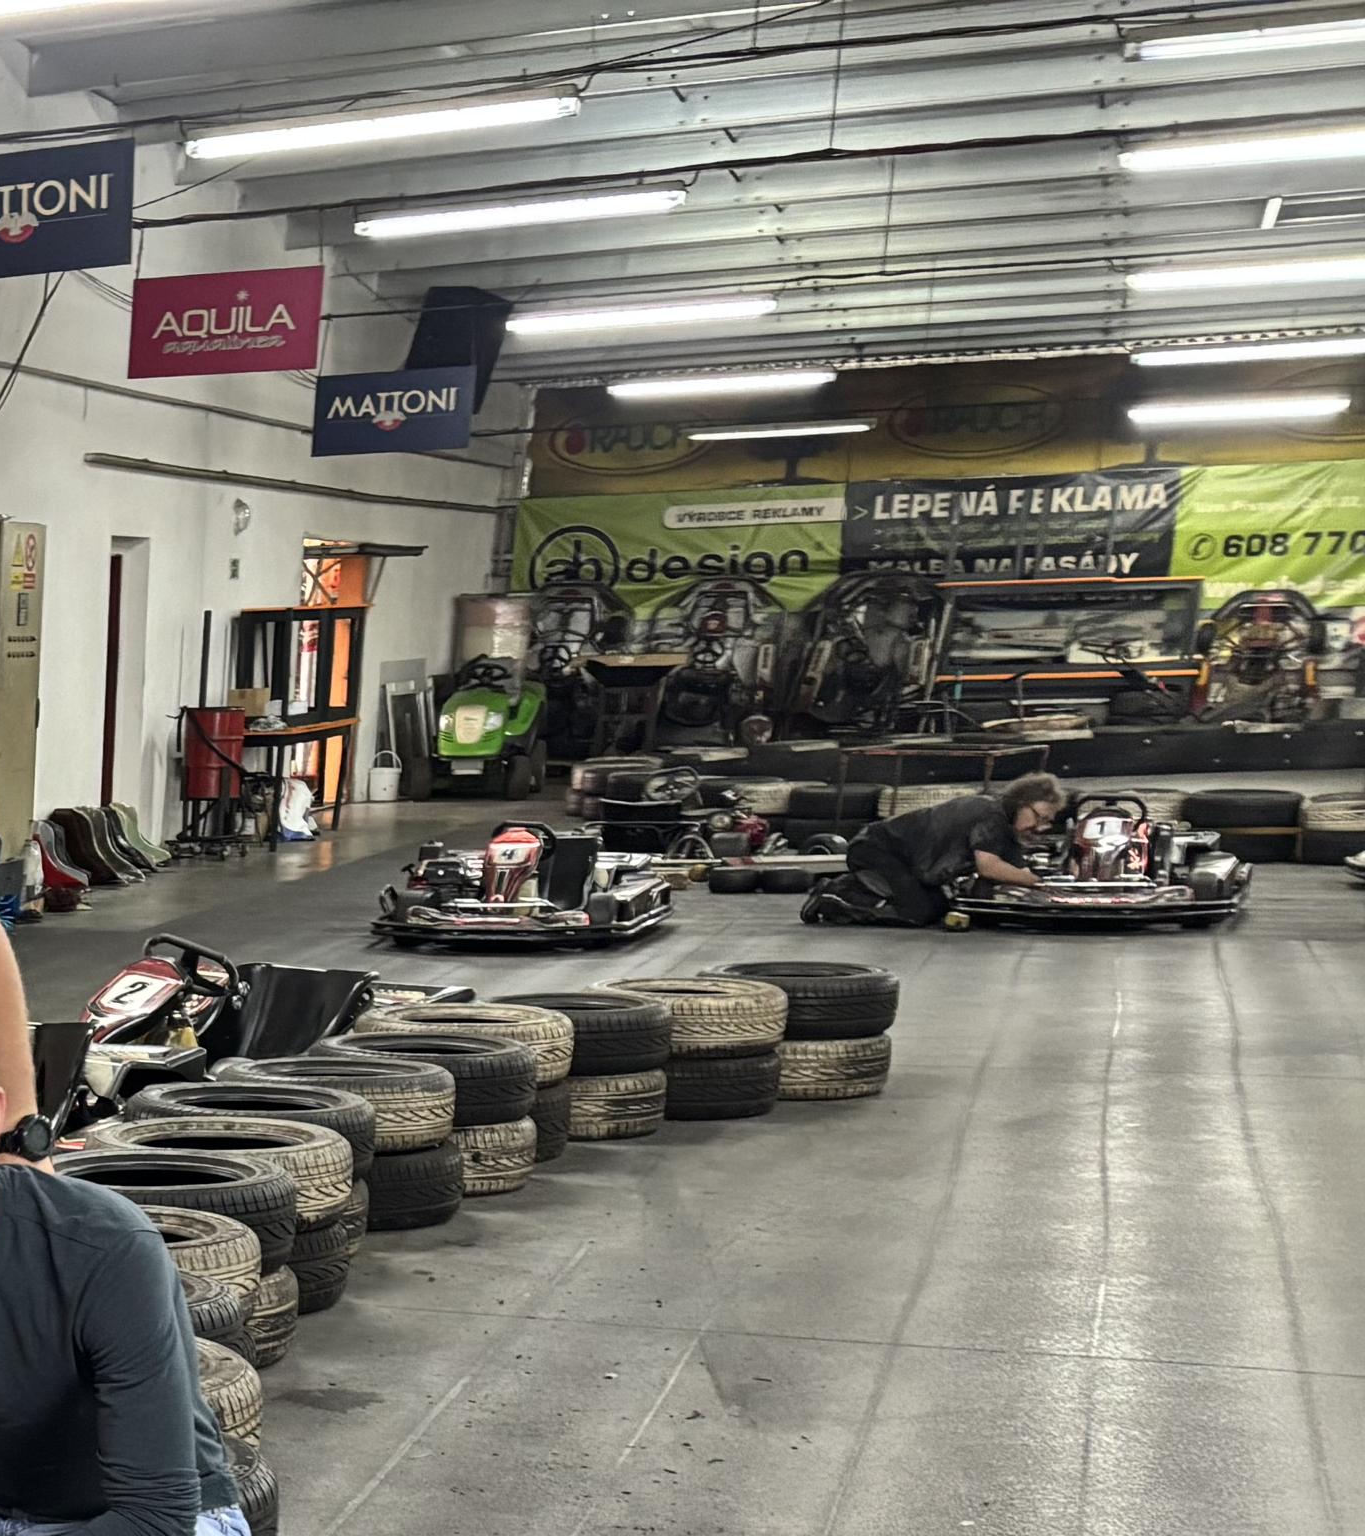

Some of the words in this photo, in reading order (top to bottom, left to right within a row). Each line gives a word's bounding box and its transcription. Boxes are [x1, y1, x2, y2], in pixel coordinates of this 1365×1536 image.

[152, 303, 296, 339] AQUILA
[327, 386, 459, 420] MATTONI
[676, 509, 745, 524] VÝROBCE
[753, 505, 826, 520] REKLAMY
[1222, 532, 1291, 558] 608
[625, 544, 810, 584] design
[974, 557, 1013, 575] NA
[501, 848, 517, 861] 4
[111, 980, 150, 1005] 2
